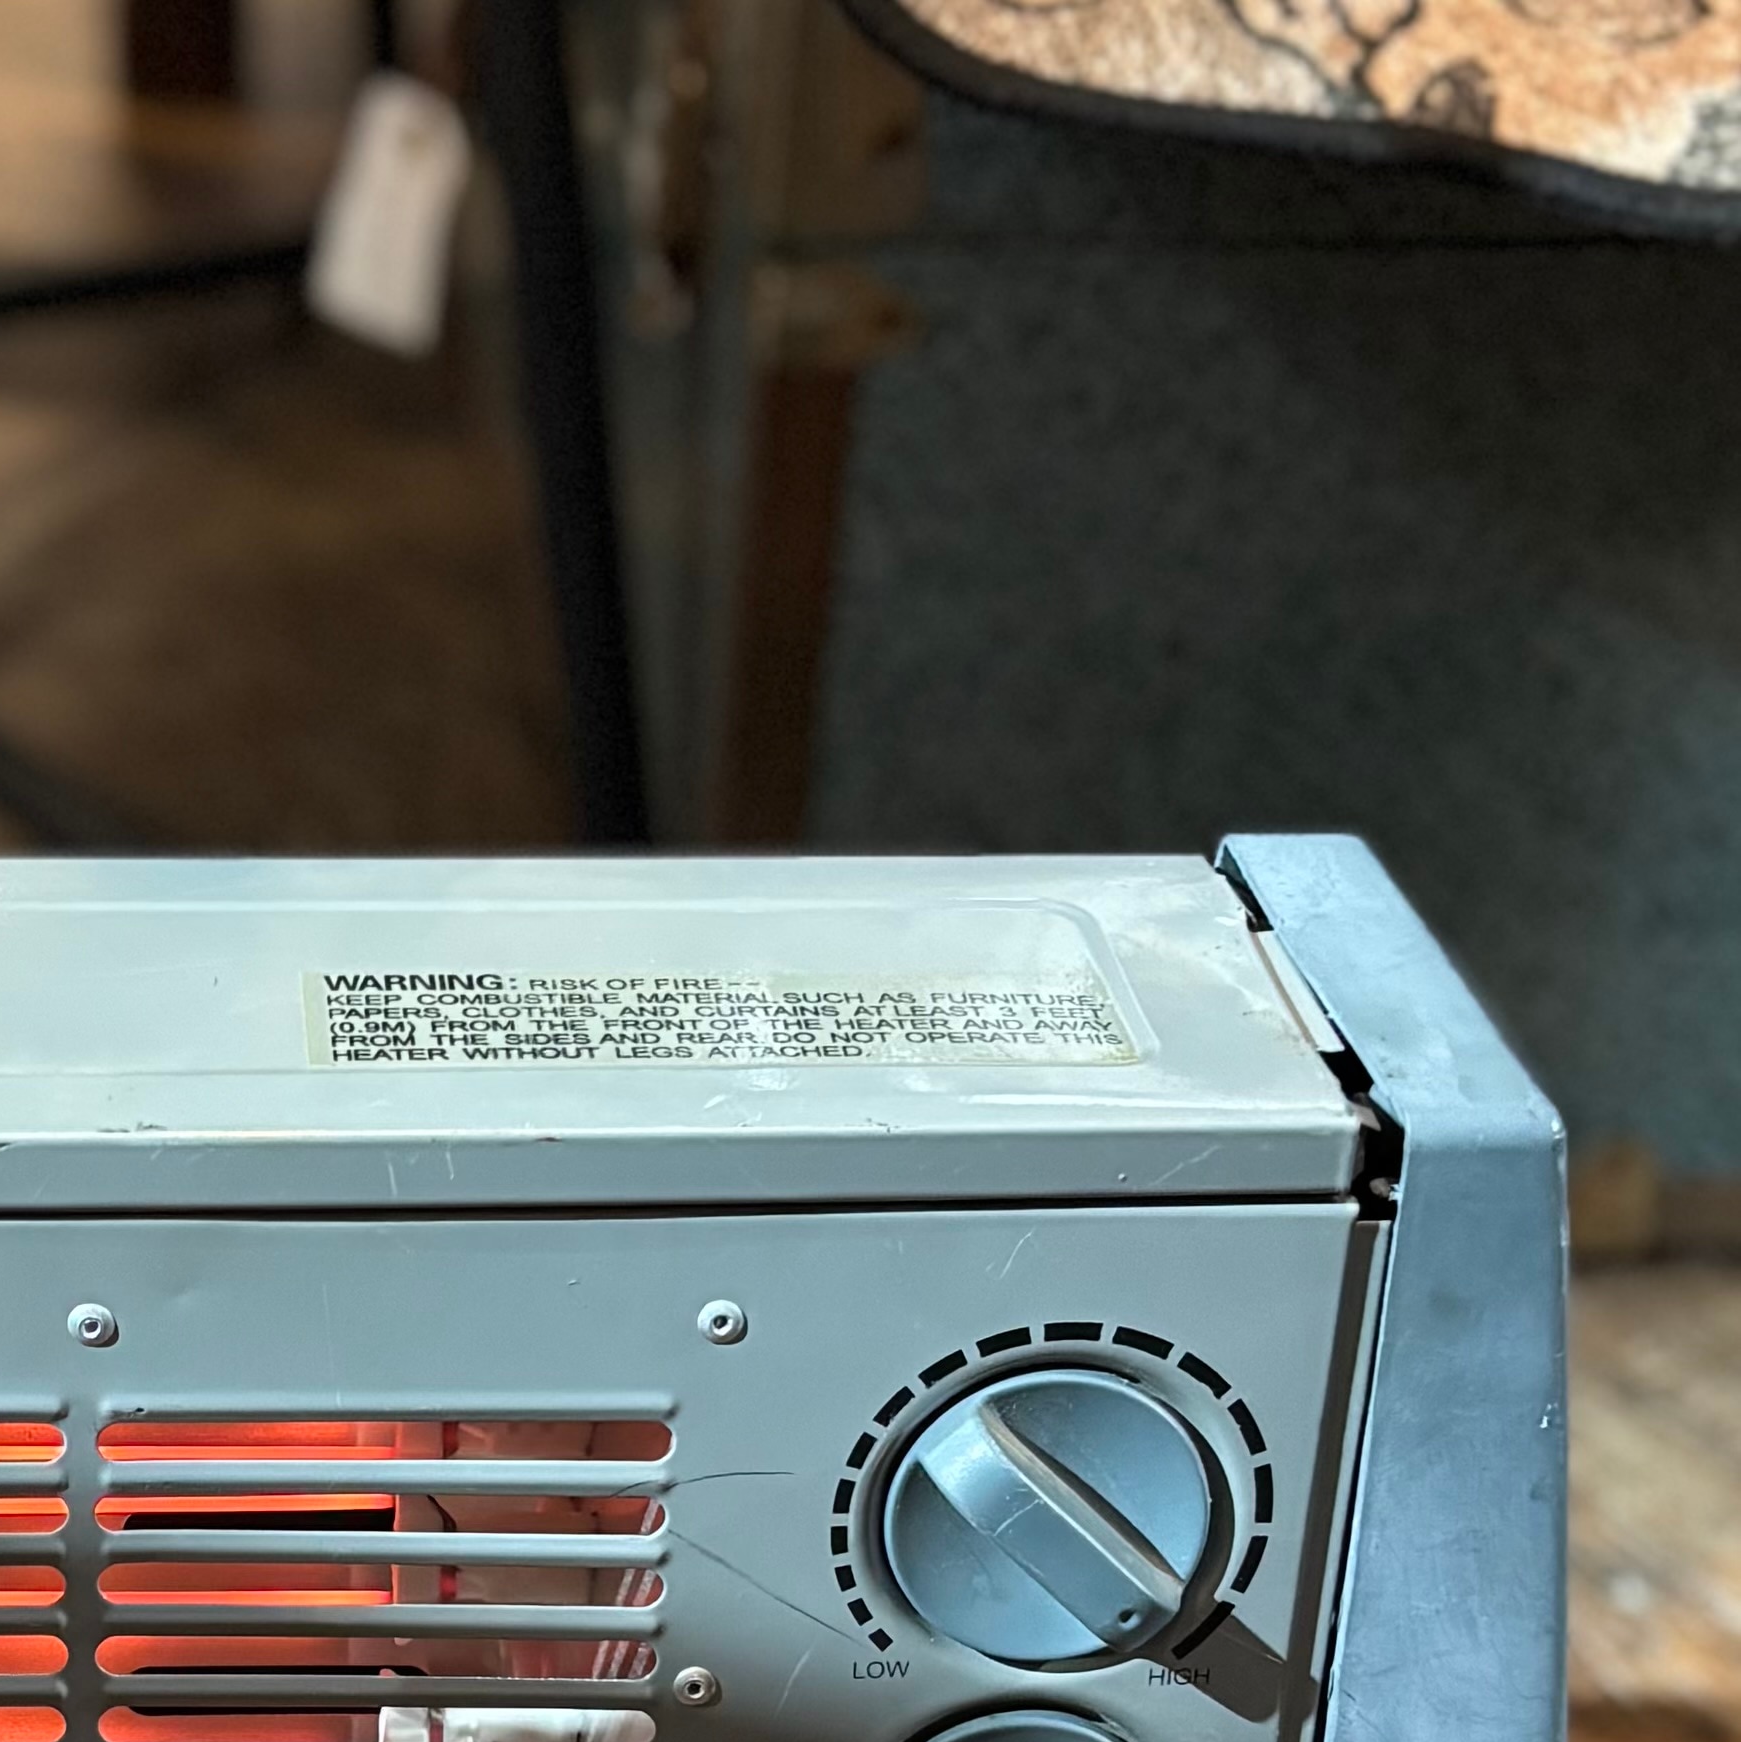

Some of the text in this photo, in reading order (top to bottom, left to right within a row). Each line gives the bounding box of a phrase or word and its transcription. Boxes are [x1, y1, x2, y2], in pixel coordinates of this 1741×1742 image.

[323, 973, 518, 992] WARNING:
[529, 978, 599, 991] RISK
[606, 978, 646, 991] OF
[327, 994, 403, 1006] KEEP
[417, 993, 623, 1006] COMBUSTIBLE
[636, 992, 777, 1005] MATERIAL
[782, 992, 865, 1004] SUCH
[878, 992, 917, 1004] AS
[328, 1007, 450, 1021] PAPERS,
[619, 1006, 680, 1018] AND
[694, 1005, 841, 1018] CURTAINS
[853, 1005, 887, 1017] AT
[894, 1005, 985, 1017] LEAST
[998, 1006, 1018, 1018] 3
[1030, 1006, 1105, 1019] FEET
[330, 1018, 1112, 1035] (0.9M) FROM THE FRONT OF THE HEATER AND AWAY
[331, 1034, 416, 1047] FROM
[429, 1033, 490, 1046] THE
[504, 1033, 591, 1045] SIDES
[599, 1032, 661, 1045] AND
[772, 1032, 817, 1044] DO
[830, 1031, 892, 1044] NOT
[904, 1031, 1046, 1044] OPERATE
[1052, 1032, 1124, 1045] THIS
[332, 1048, 450, 1062] HEATER
[462, 1046, 600, 1060] WITHOUT
[614, 1046, 695, 1059] LEGS
[852, 1660, 910, 1680] LOW
[1148, 1666, 1210, 1687] HIGH
